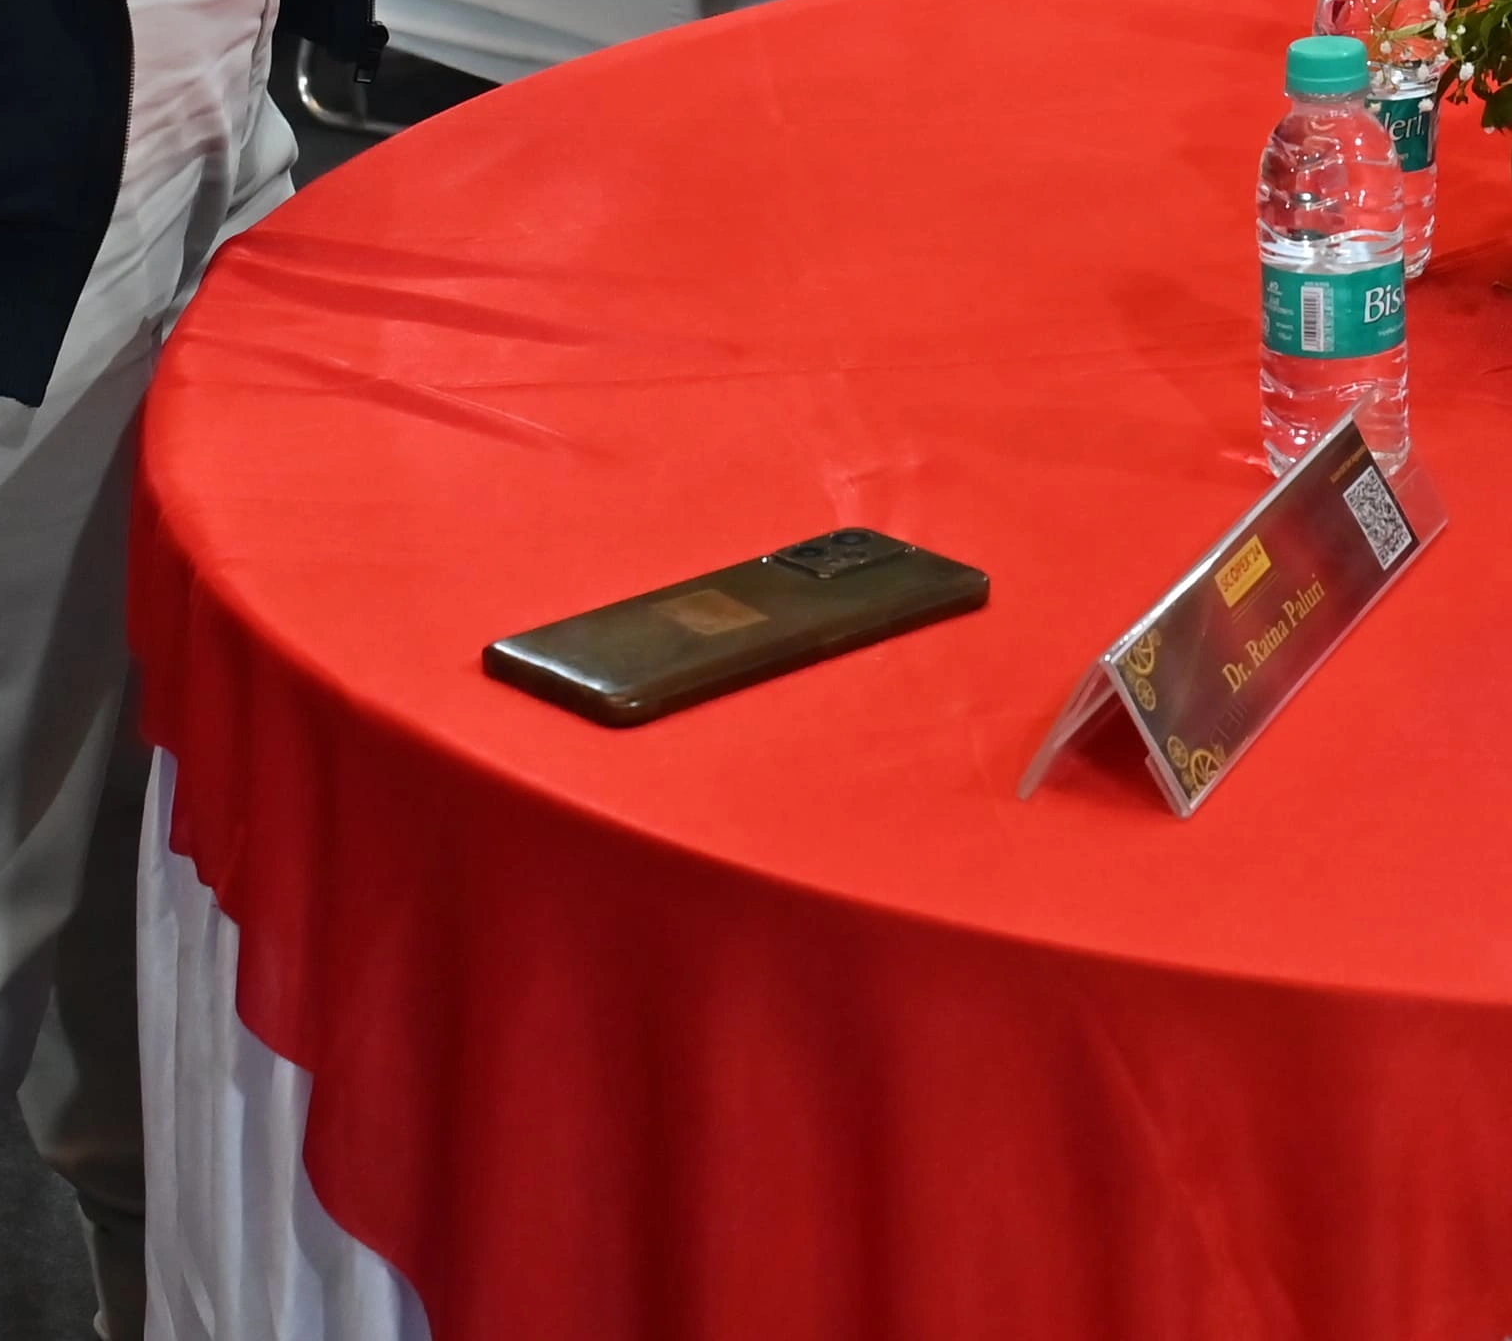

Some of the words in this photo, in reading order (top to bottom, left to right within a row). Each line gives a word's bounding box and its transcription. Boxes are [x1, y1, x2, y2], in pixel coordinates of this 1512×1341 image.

[1221, 664, 1253, 693] Dr.
[1245, 619, 1290, 671] Ratna
[1282, 577, 1326, 629] Paluri
